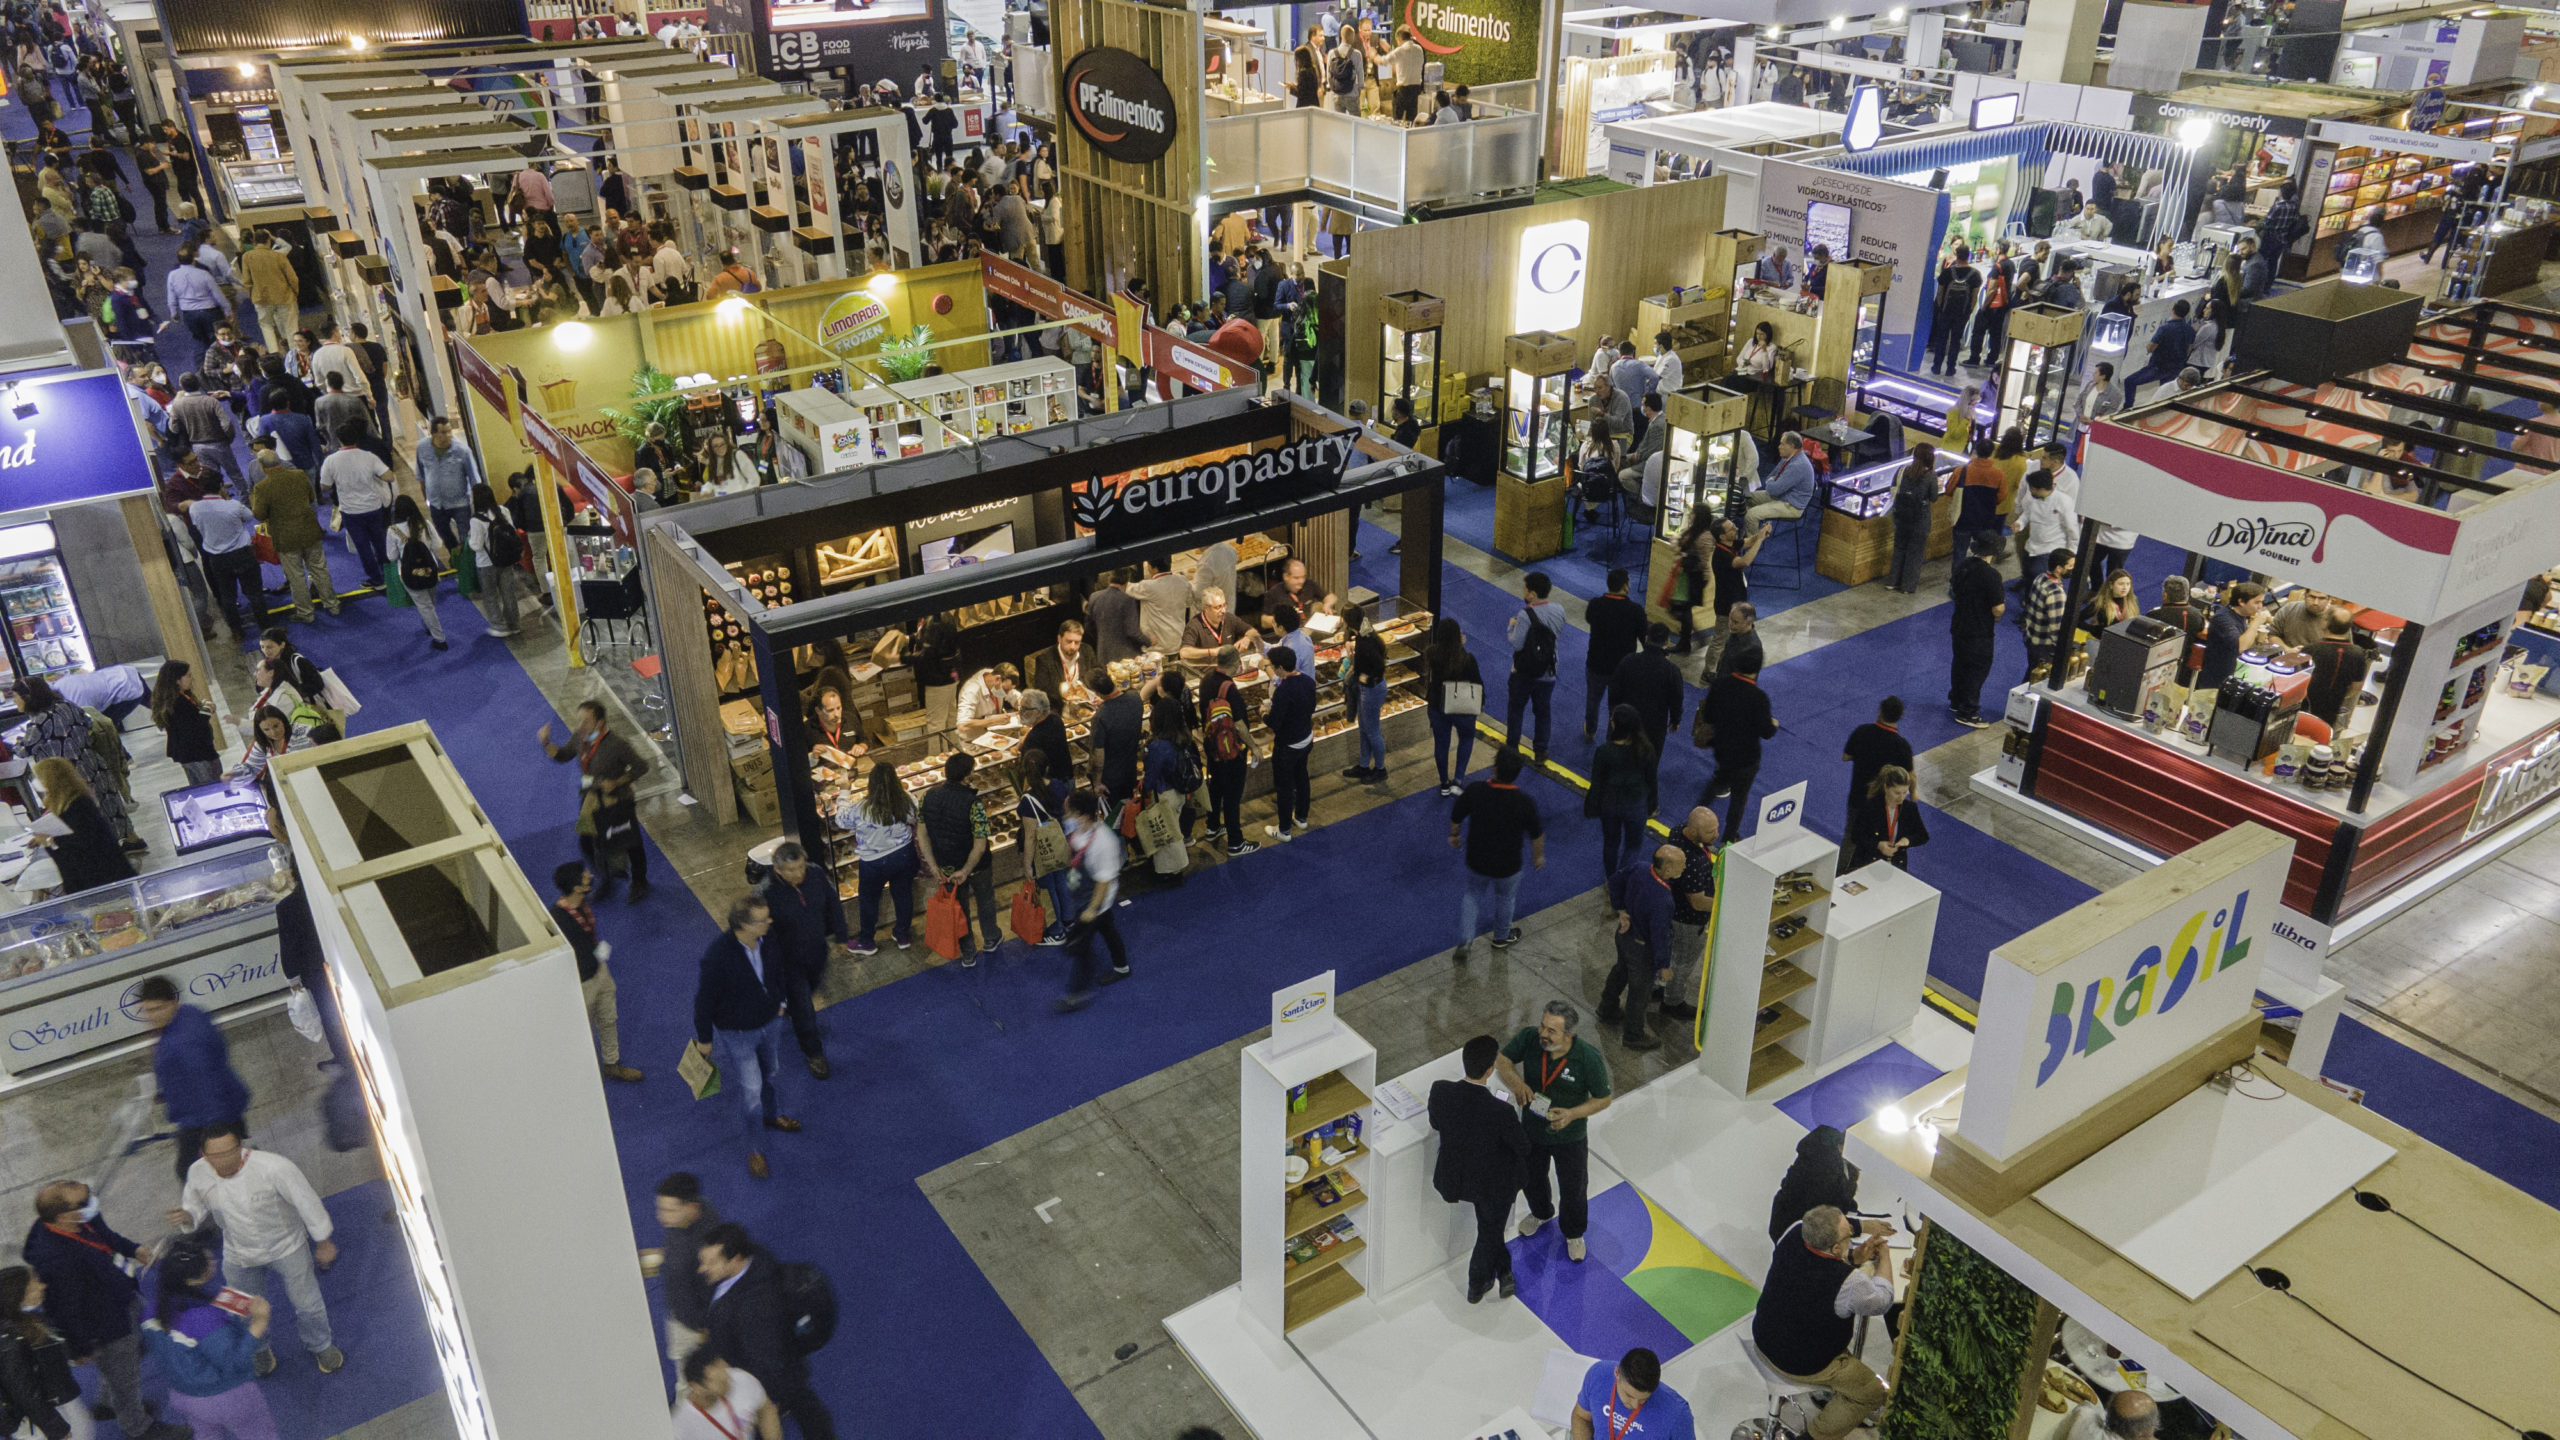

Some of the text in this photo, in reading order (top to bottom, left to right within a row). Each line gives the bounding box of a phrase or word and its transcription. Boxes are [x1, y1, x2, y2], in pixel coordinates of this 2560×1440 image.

[1416, 2, 1511, 42] PFalimentos
[769, 31, 821, 71] ICB
[823, 39, 851, 50] FOOD
[1080, 82, 1165, 134] PFalimentos
[1797, 185, 1887, 213] VIDRIOS Y PLÁSTICOS?
[1860, 185, 1872, 197] DE
[1766, 204, 1772, 212] 2
[1860, 235, 1898, 252] REDUCIR
[1858, 249, 1899, 267] RECICLAR
[823, 303, 882, 338] LIMONADA
[835, 324, 884, 353] FROZEN
[1123, 432, 1359, 514] europastry
[2206, 517, 2316, 555] DaVinci
[2259, 548, 2301, 567] GOURMET
[1769, 803, 1793, 821] RAR
[8, 953, 280, 1051] South Wind
[1283, 1005, 1305, 1019] Santa
[1304, 997, 1325, 1010] Clara
